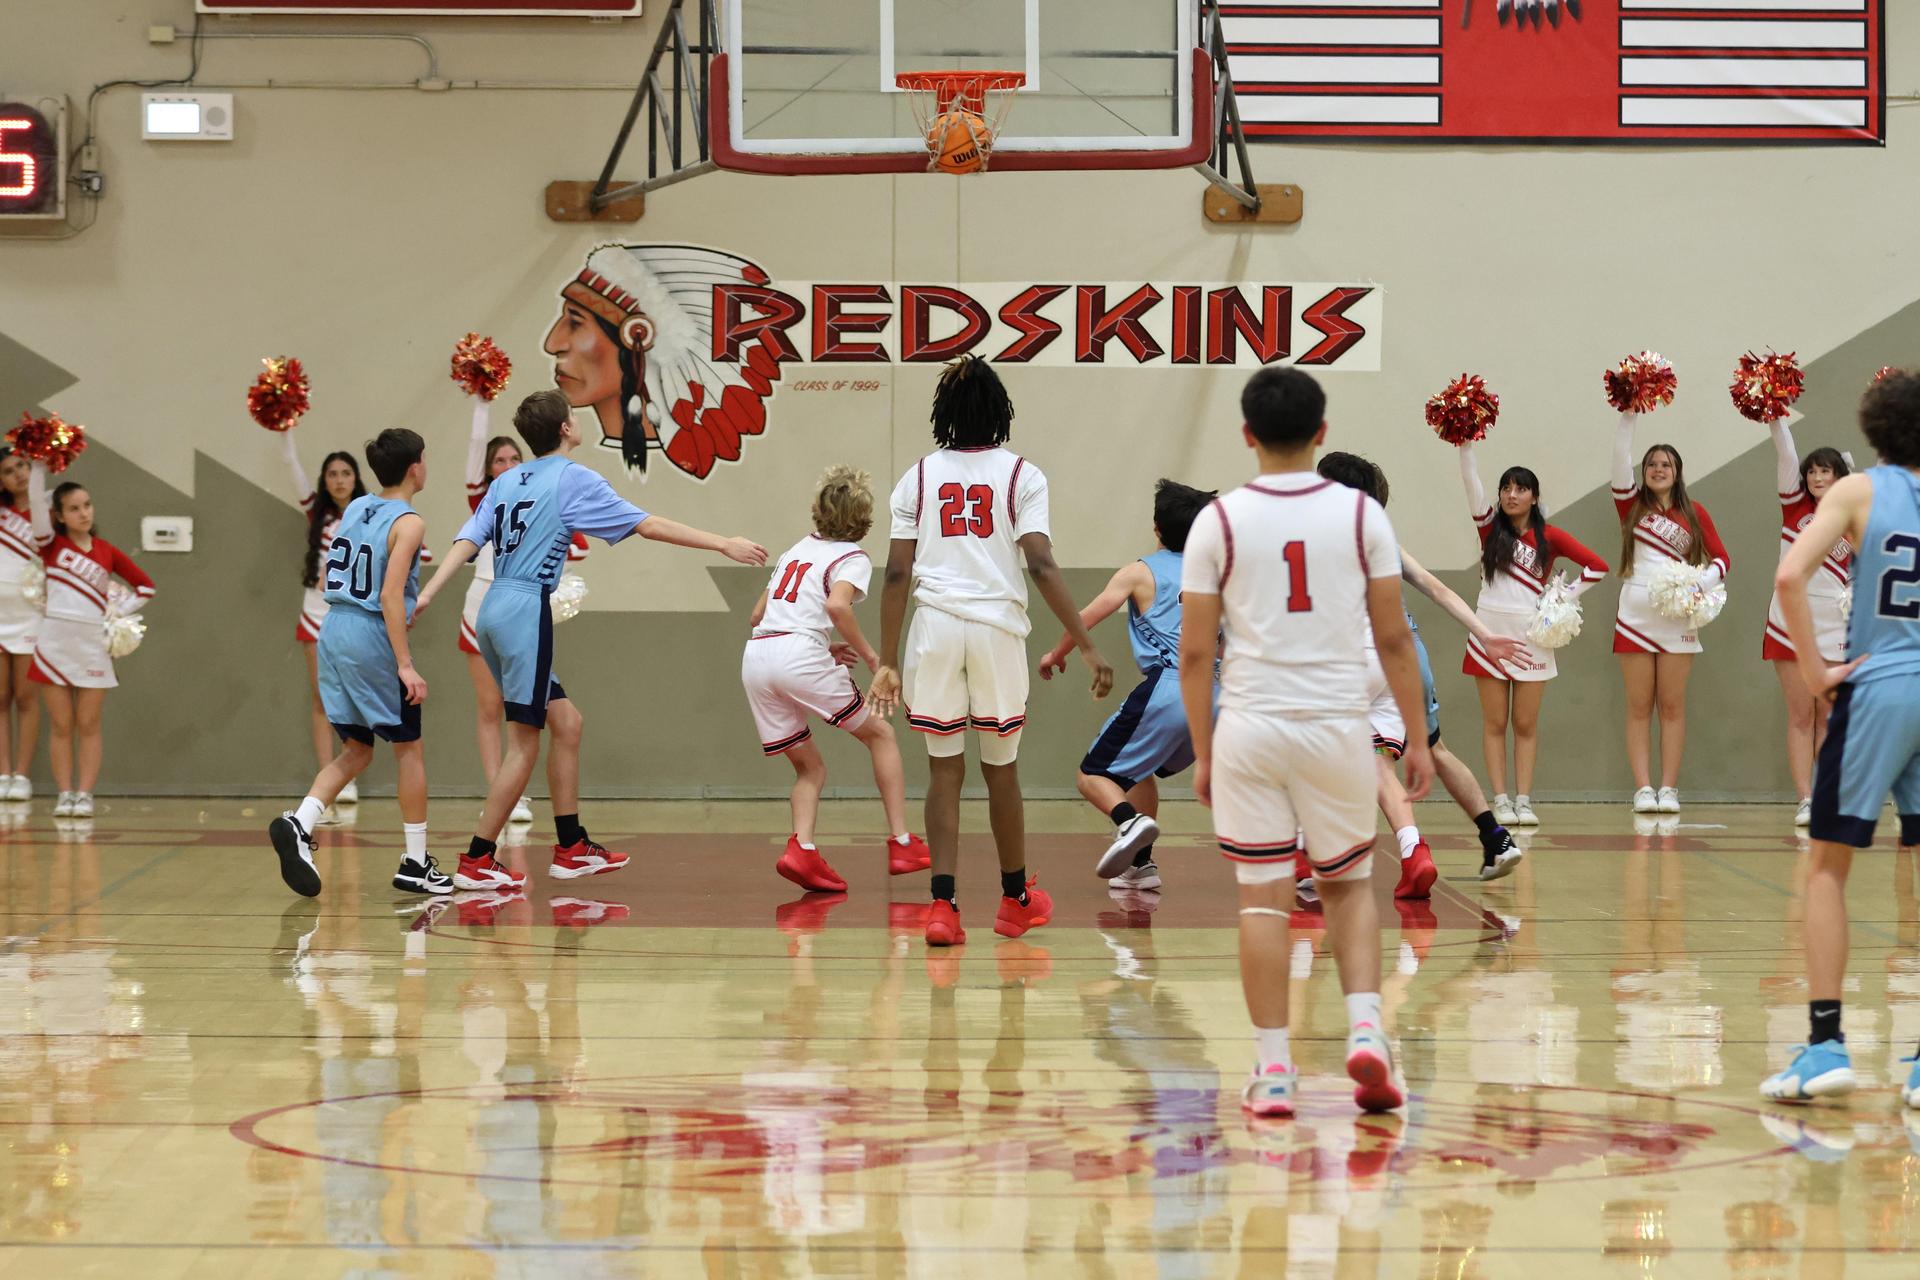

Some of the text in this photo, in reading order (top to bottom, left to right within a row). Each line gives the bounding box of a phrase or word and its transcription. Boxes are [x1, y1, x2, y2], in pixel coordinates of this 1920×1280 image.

[711, 283, 1375, 365] REDSKINS
[793, 380, 880, 391] CLASS OF 1999
[518, 472, 534, 486] Y
[492, 499, 536, 558] 15
[938, 482, 994, 538] 23
[325, 535, 374, 601] 20
[772, 559, 813, 603] 11
[1282, 540, 1313, 613] 1
